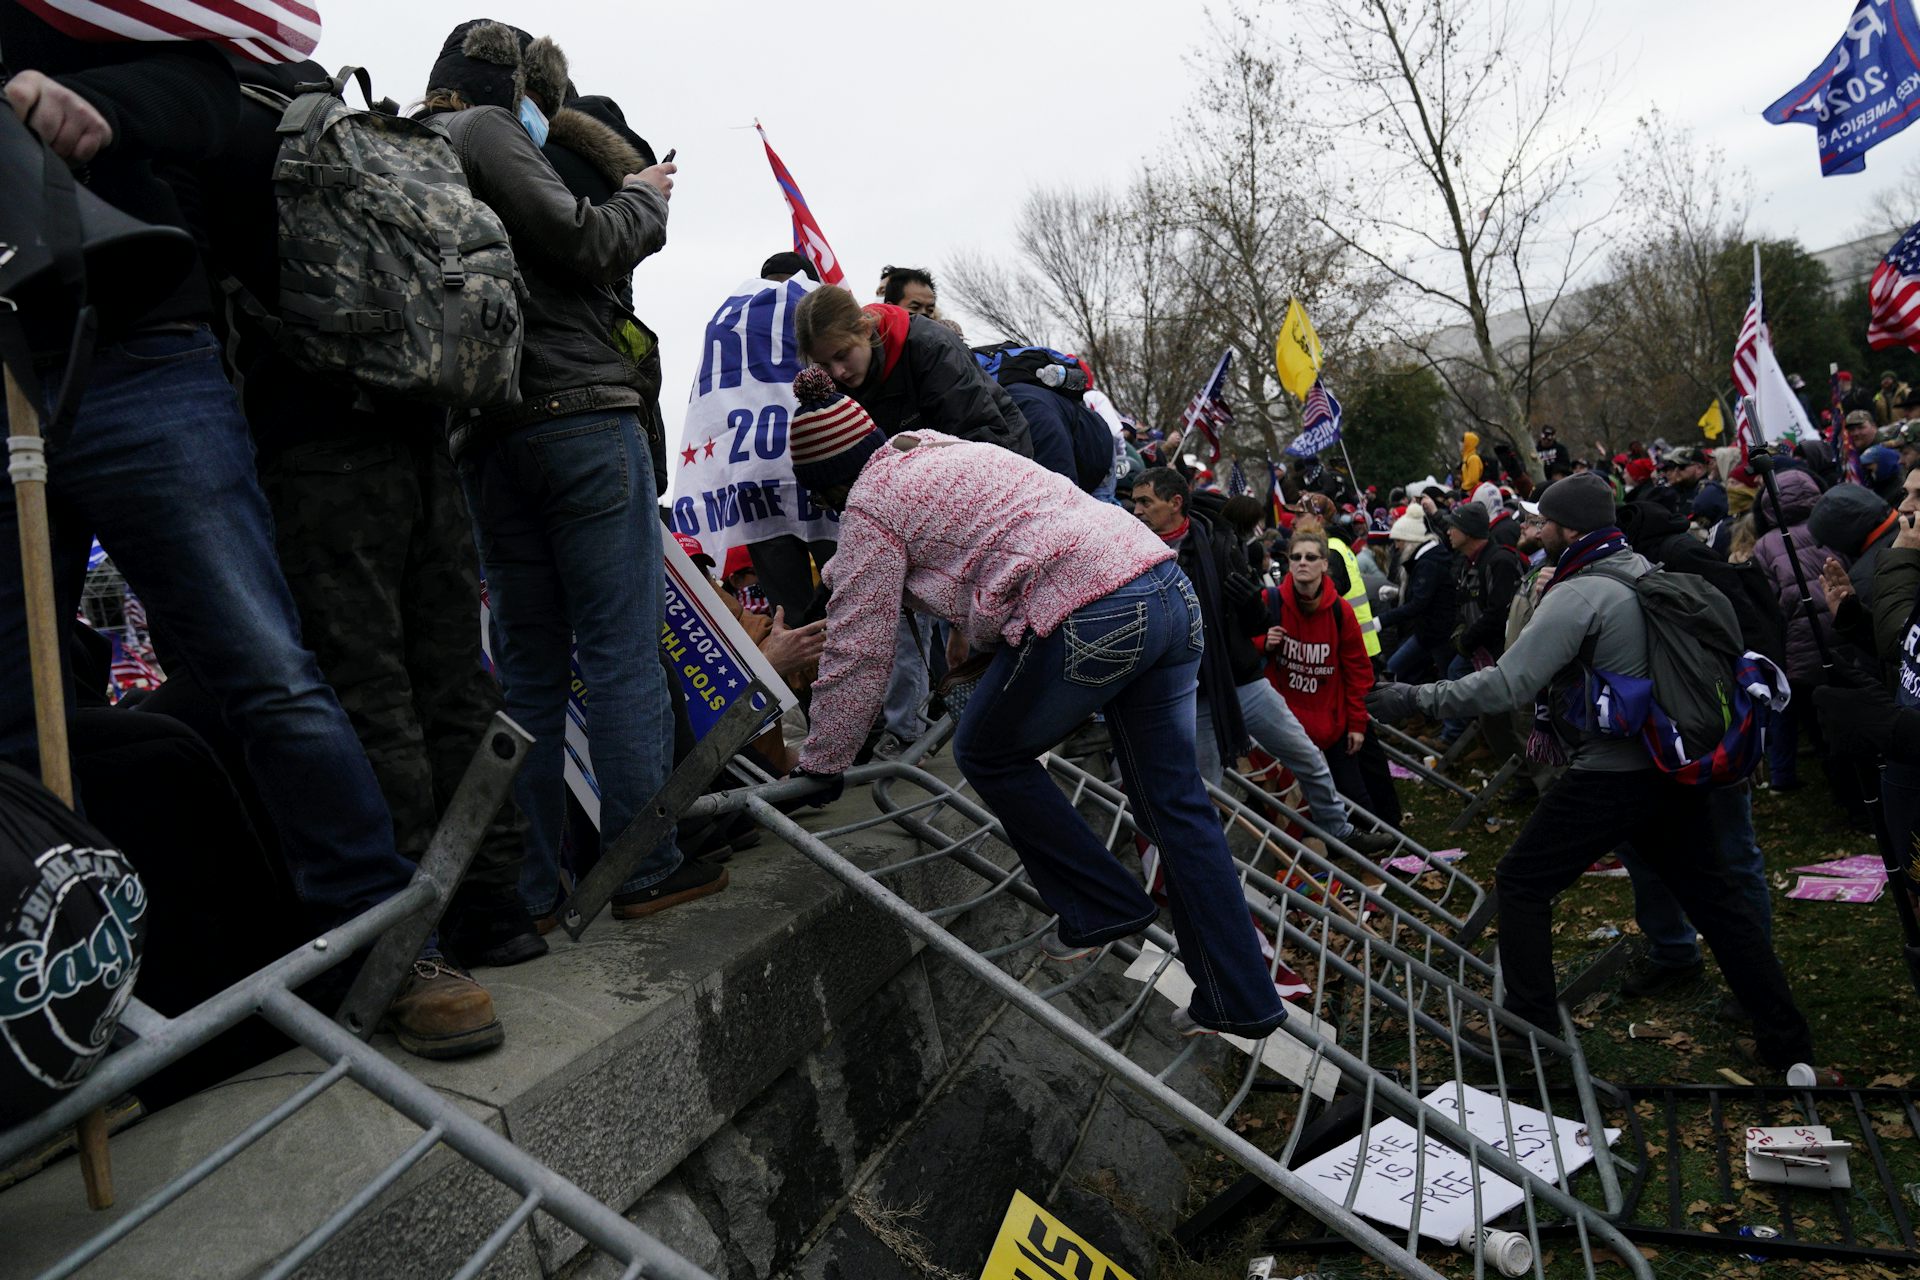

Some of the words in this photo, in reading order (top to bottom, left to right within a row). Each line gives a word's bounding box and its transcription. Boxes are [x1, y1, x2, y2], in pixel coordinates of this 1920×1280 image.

[481, 298, 517, 336] US
[727, 404, 788, 464] 20
[702, 479, 786, 534] MORE
[665, 580, 723, 665] 2021-20
[1282, 635, 1331, 665] TRUMP
[1314, 665, 1335, 677] GREAT
[683, 663, 727, 712] STOP
[1288, 672, 1318, 694] 2020
[1319, 1135, 1414, 1181] WHERE
[1376, 1163, 1415, 1182] IS
[1399, 1170, 1487, 1212] FREE
